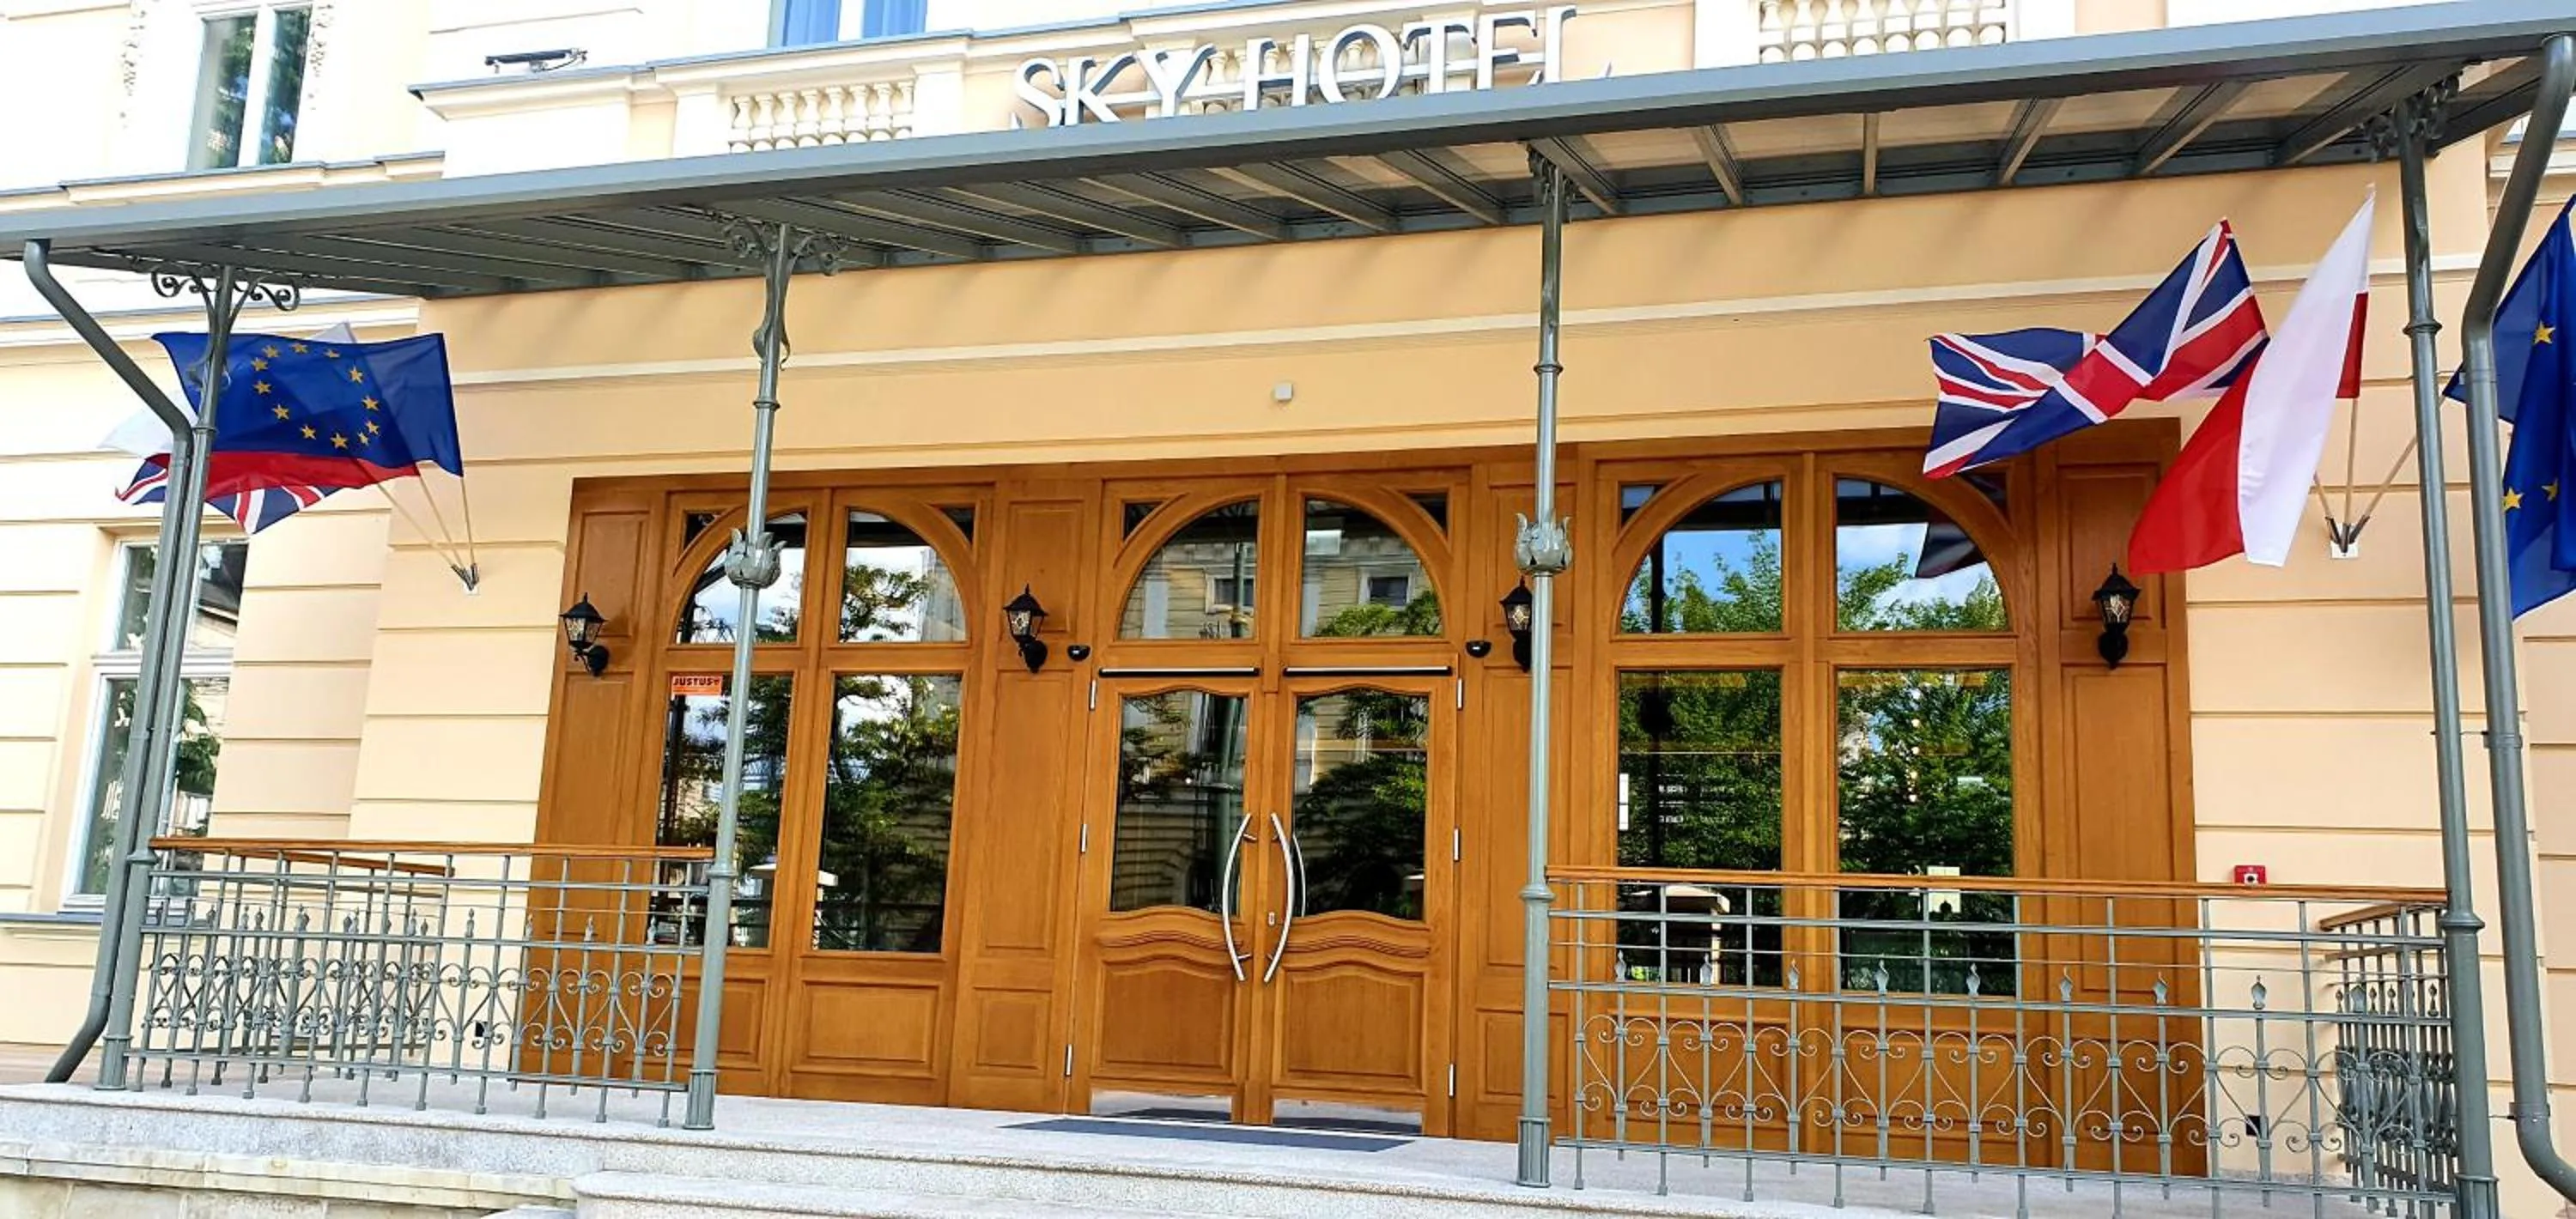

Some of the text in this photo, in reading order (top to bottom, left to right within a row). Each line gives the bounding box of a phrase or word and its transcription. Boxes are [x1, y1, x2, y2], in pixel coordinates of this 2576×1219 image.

[1010, 6, 1611, 128] SKY HOTEL
[673, 677, 716, 686] JUSTUS
